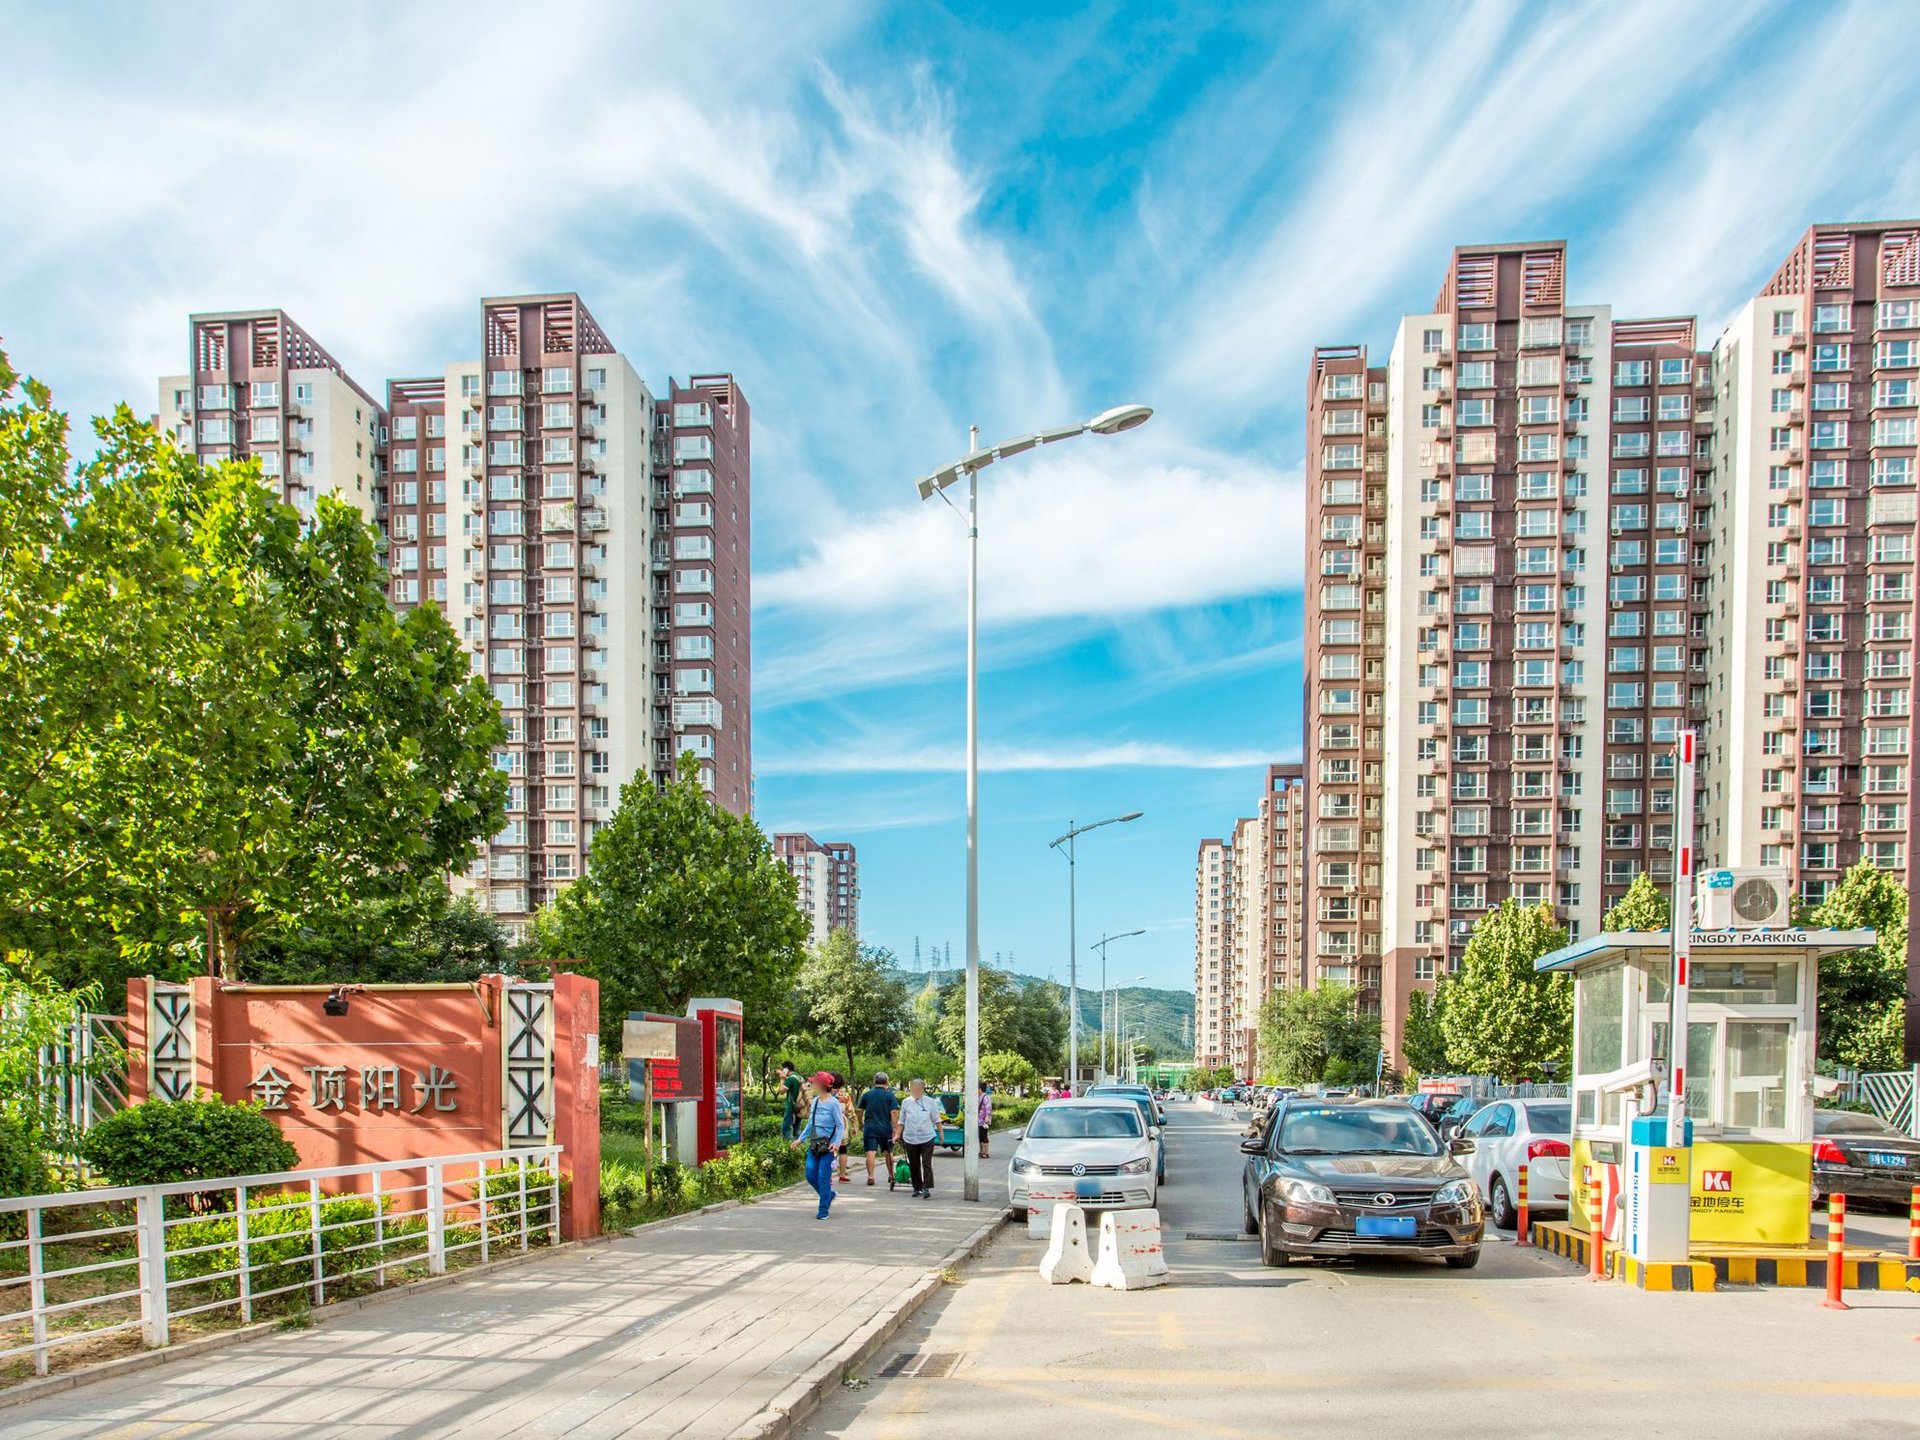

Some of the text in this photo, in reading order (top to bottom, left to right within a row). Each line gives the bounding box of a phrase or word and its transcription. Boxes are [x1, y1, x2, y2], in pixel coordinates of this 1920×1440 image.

[1742, 934, 1806, 942] PARKING
[246, 1064, 458, 1113] 金顶阳光
[1690, 1196, 1745, 1208] 金地停车
